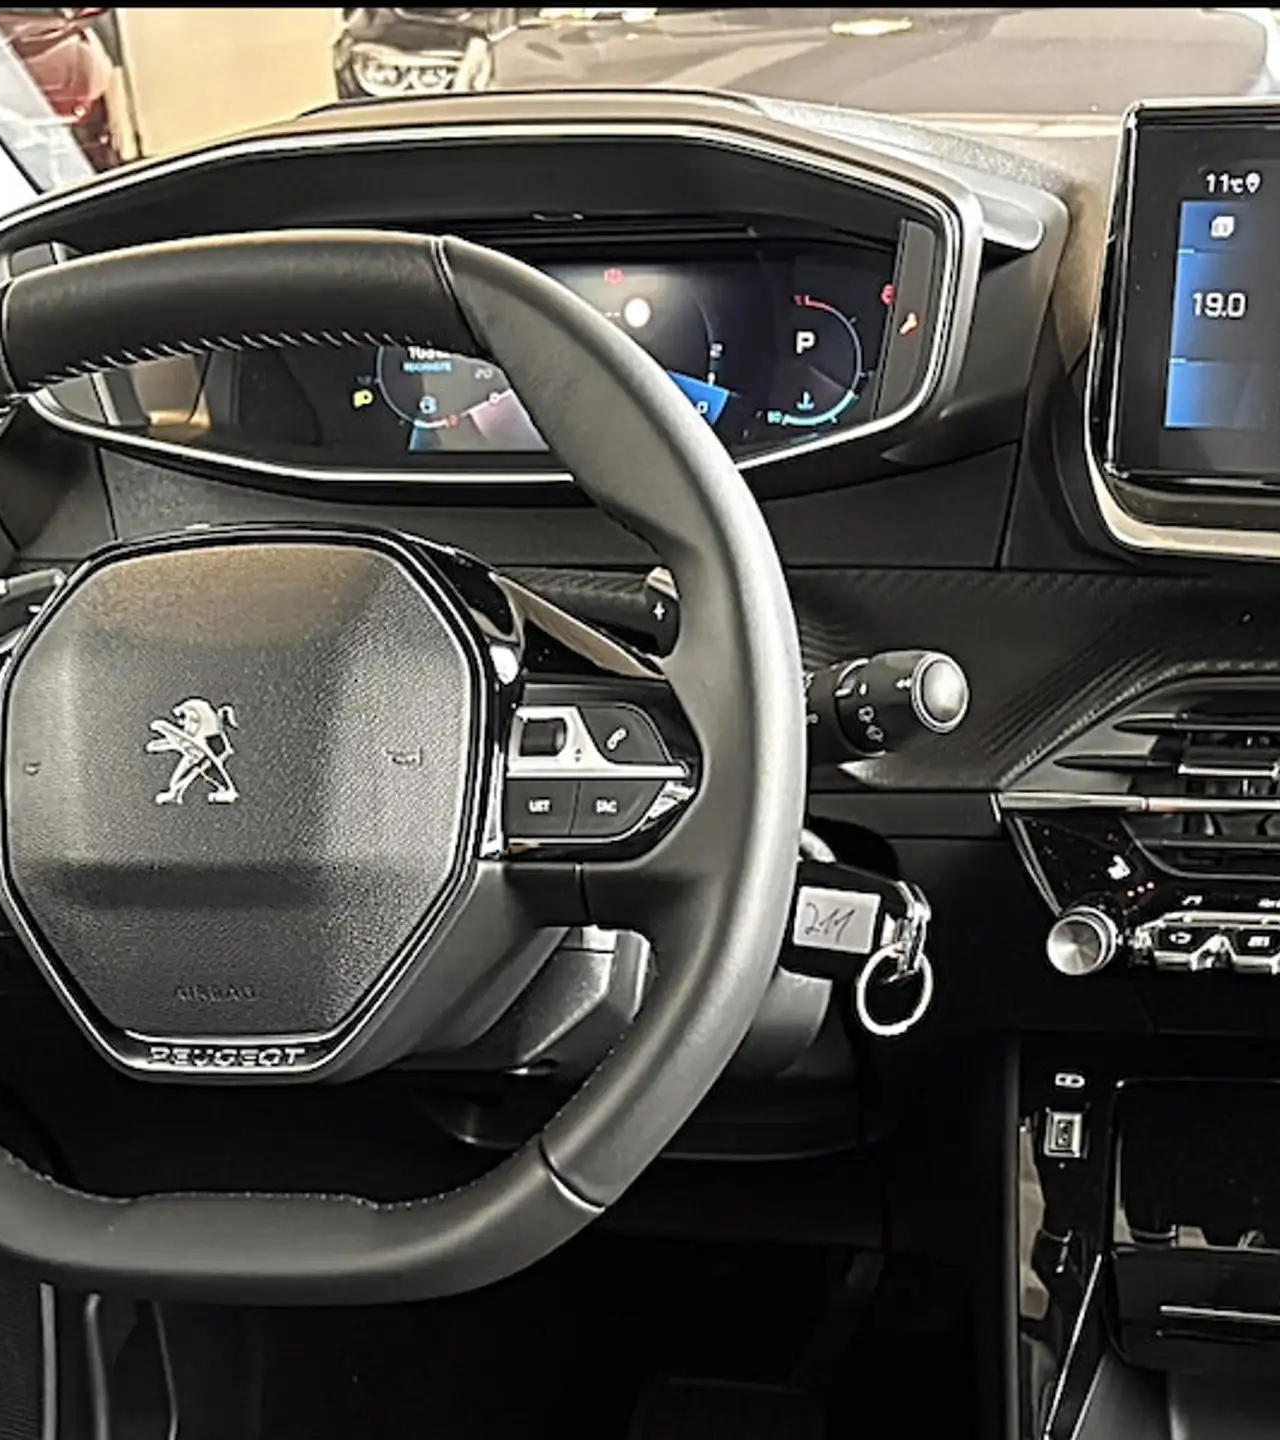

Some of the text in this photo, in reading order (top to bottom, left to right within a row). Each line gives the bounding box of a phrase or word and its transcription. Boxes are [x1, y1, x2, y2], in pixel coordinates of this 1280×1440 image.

[1192, 292, 1246, 318] 19.0
[796, 330, 816, 354] P
[150, 1047, 305, 1066] PEUGEOT
